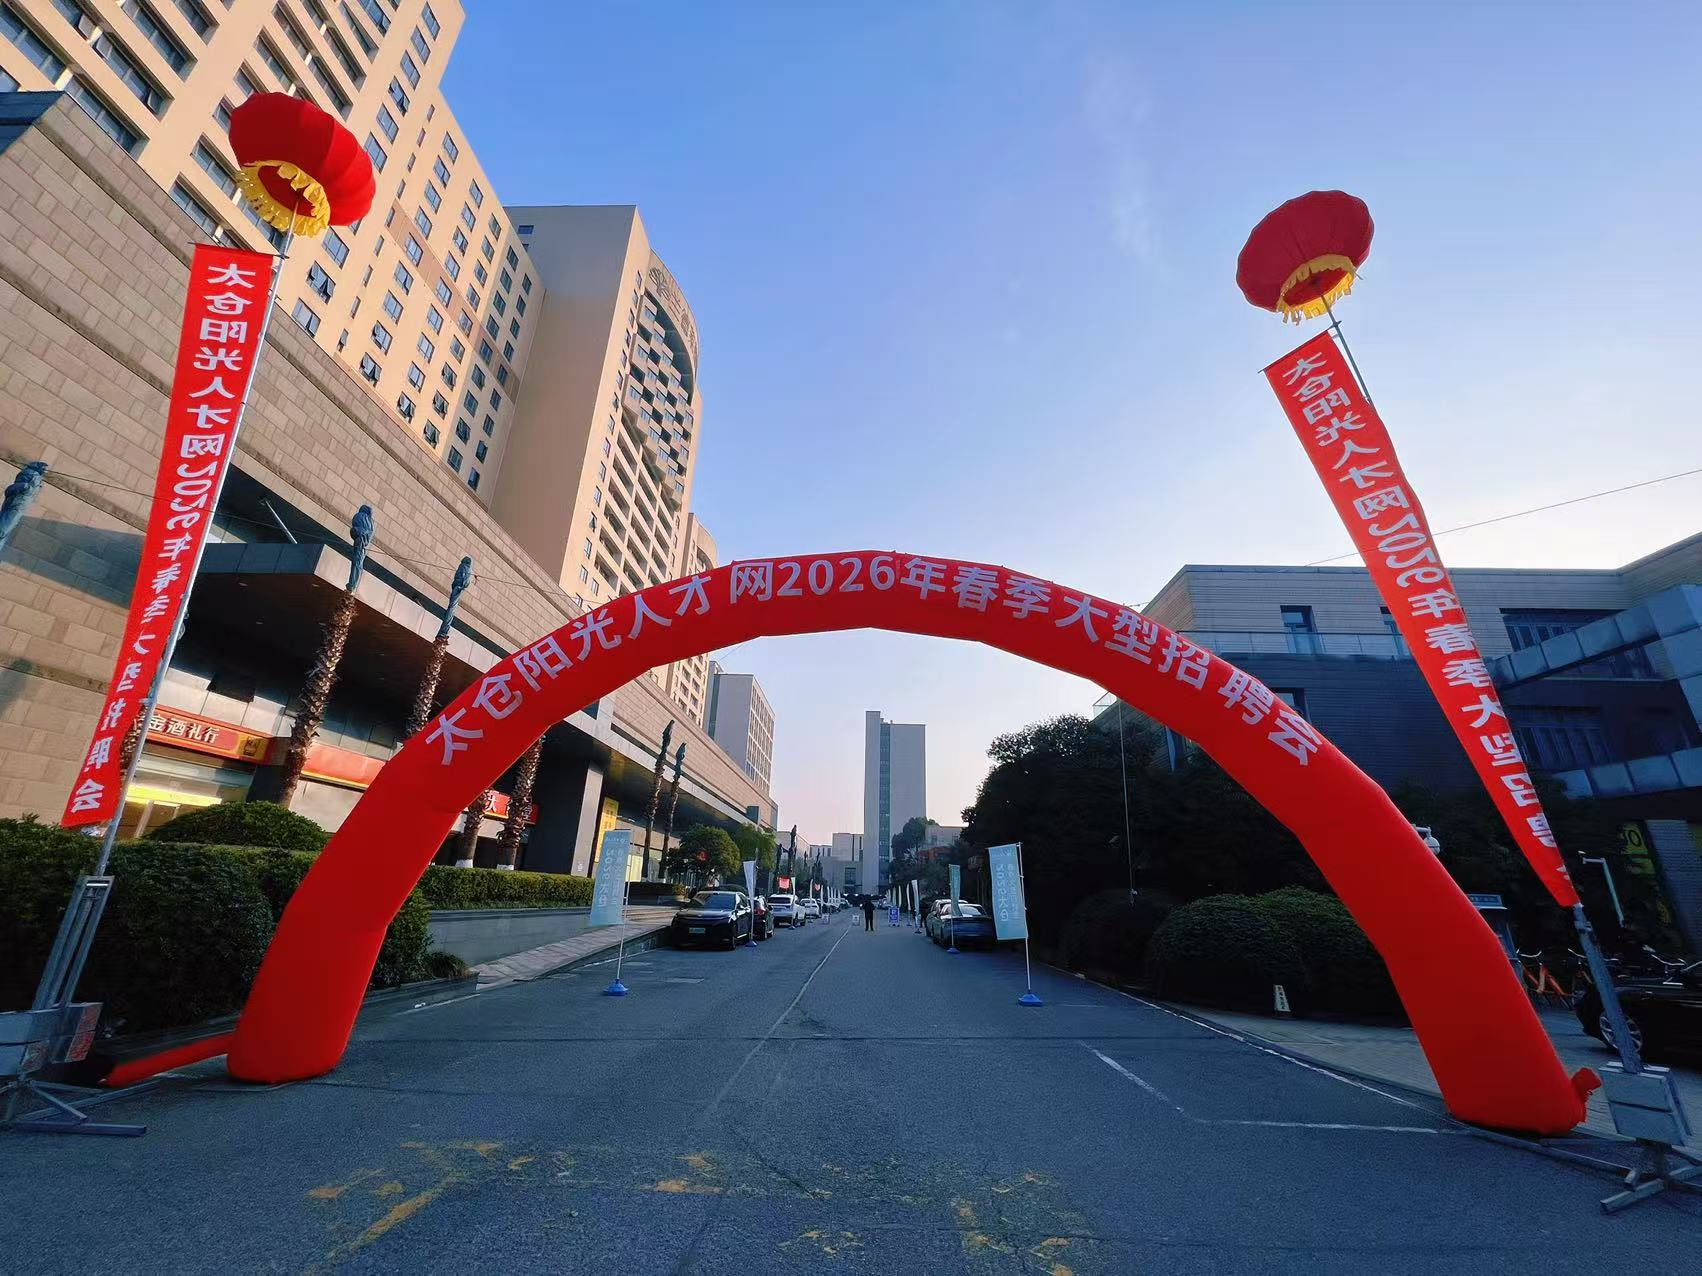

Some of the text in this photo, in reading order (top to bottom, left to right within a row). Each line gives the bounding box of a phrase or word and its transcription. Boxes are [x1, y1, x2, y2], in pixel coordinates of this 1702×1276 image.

[425, 555, 1323, 767] 太仓阳光人才网2026年春季大型招聘会
